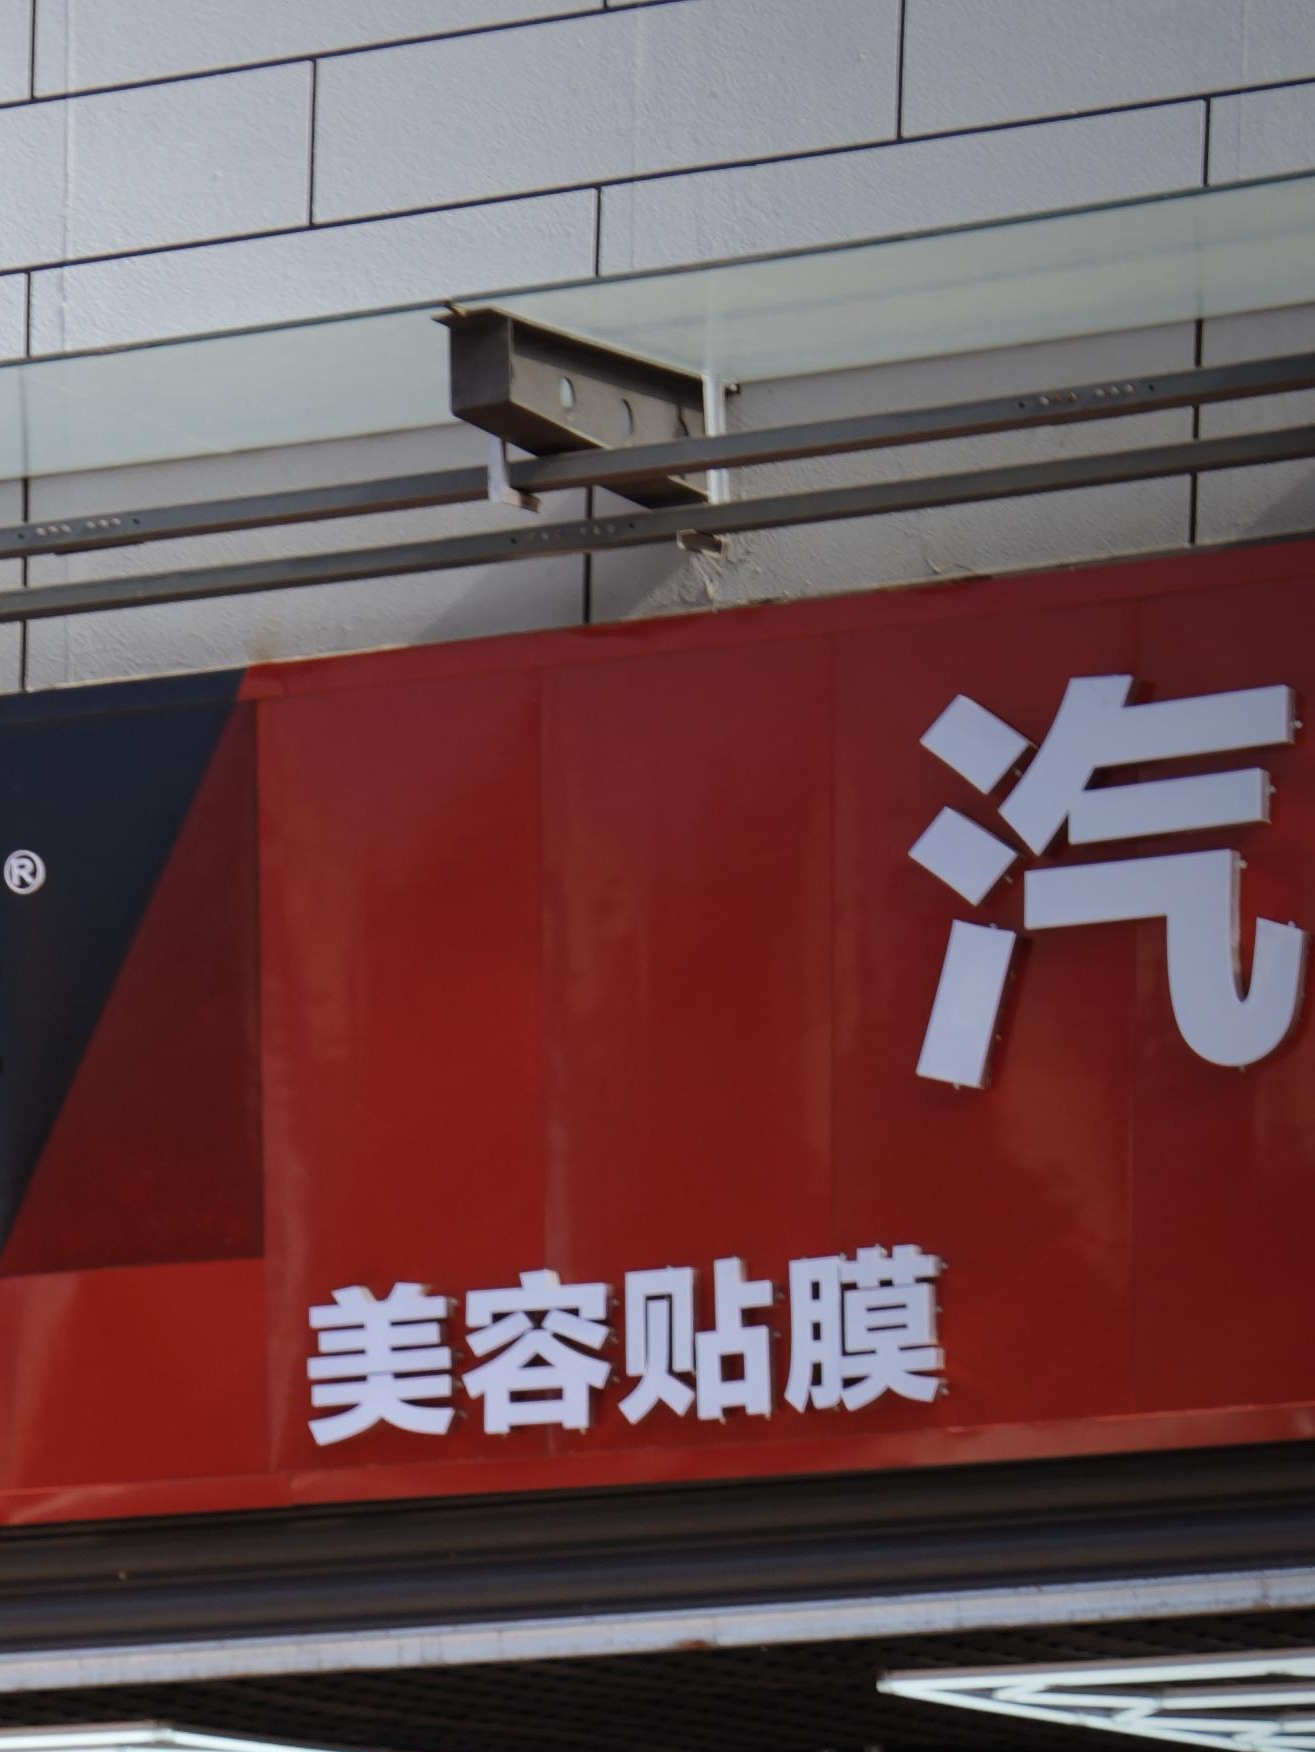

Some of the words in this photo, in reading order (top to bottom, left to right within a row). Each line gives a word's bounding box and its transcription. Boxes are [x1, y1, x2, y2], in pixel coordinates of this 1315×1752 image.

[909, 676, 1302, 1088] 汽
[308, 1244, 944, 1446] 美容贴膜
